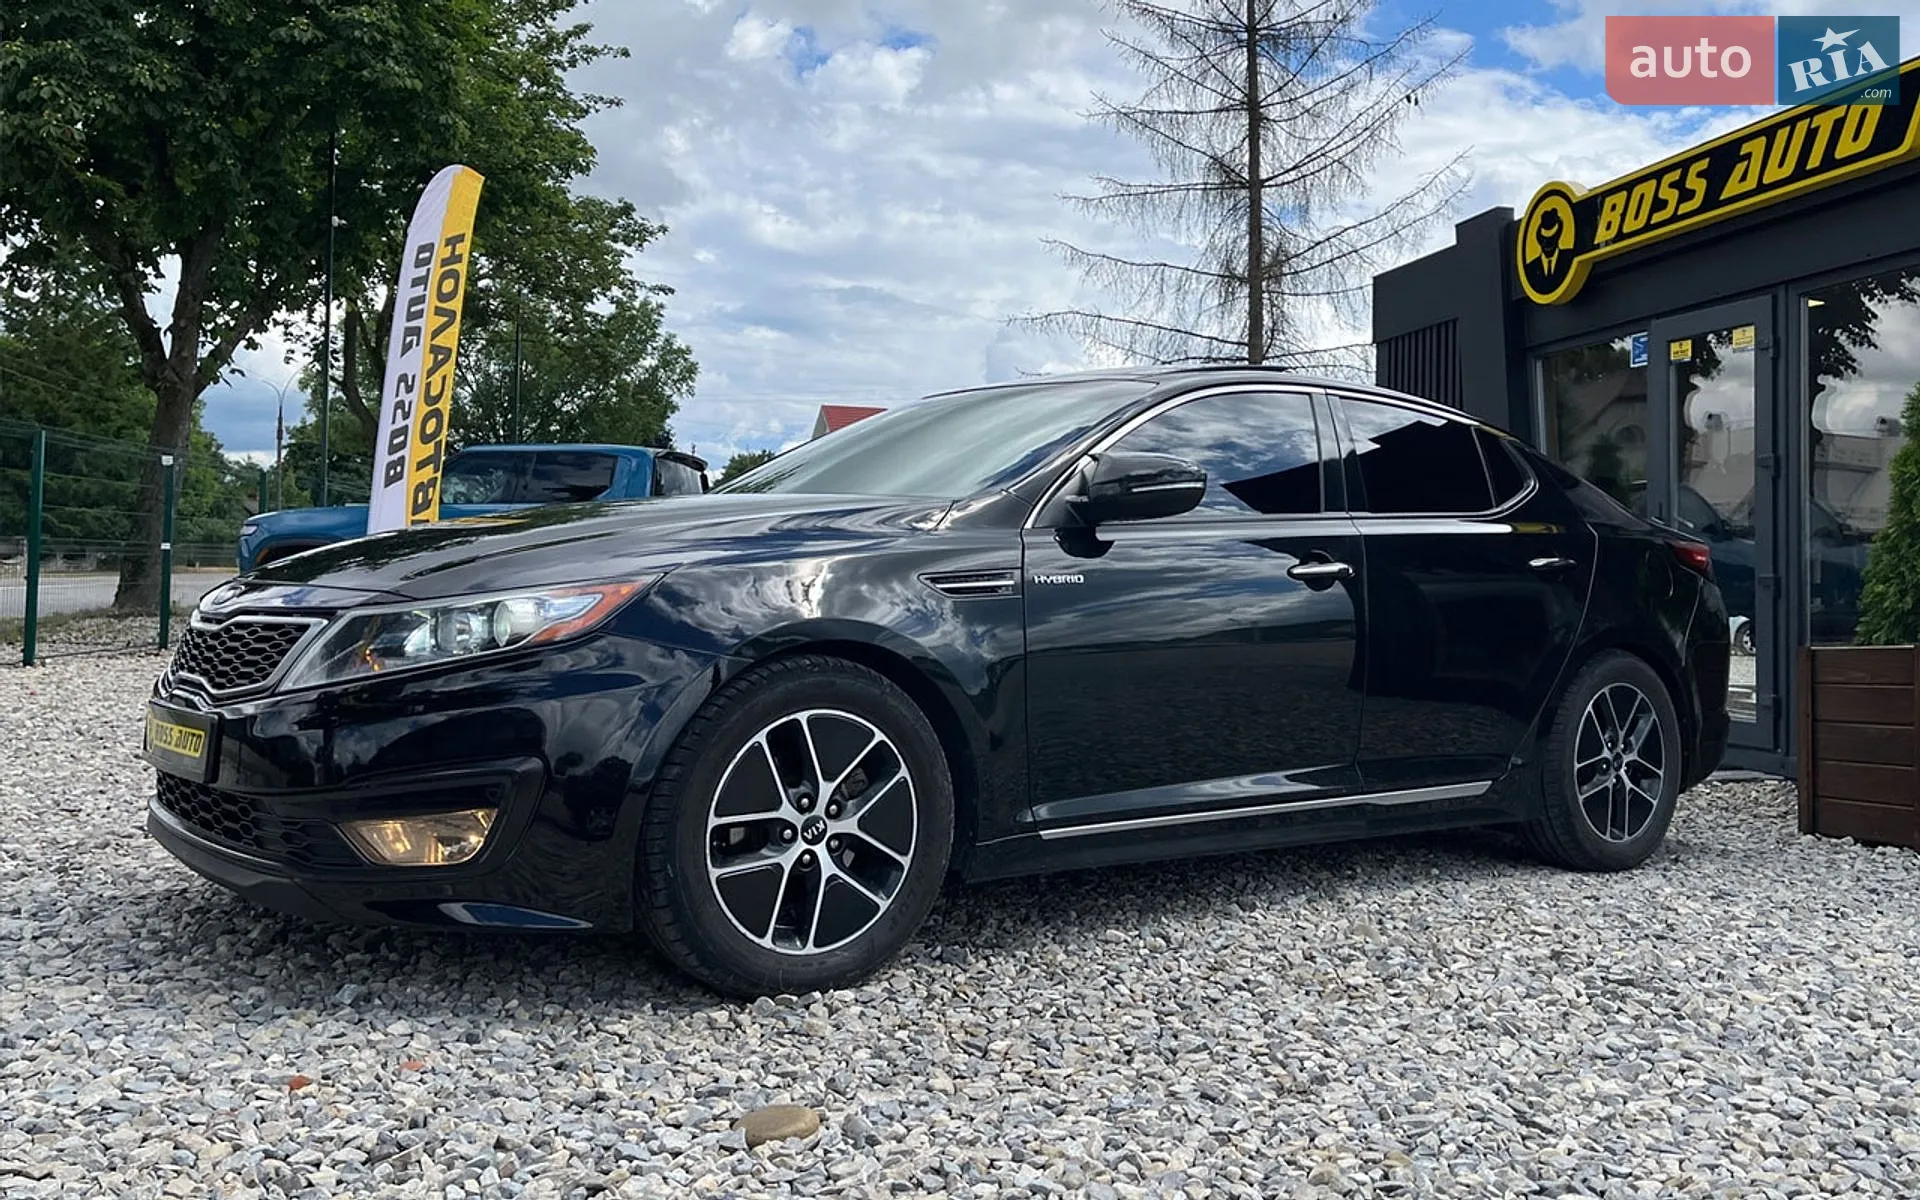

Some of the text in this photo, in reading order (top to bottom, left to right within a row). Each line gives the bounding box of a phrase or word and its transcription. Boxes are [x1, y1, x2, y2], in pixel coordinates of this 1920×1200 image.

[1594, 96, 1885, 245] BOSS AUTO
[1033, 574, 1084, 584] HYBRID
[175, 730, 202, 752] AUTO
